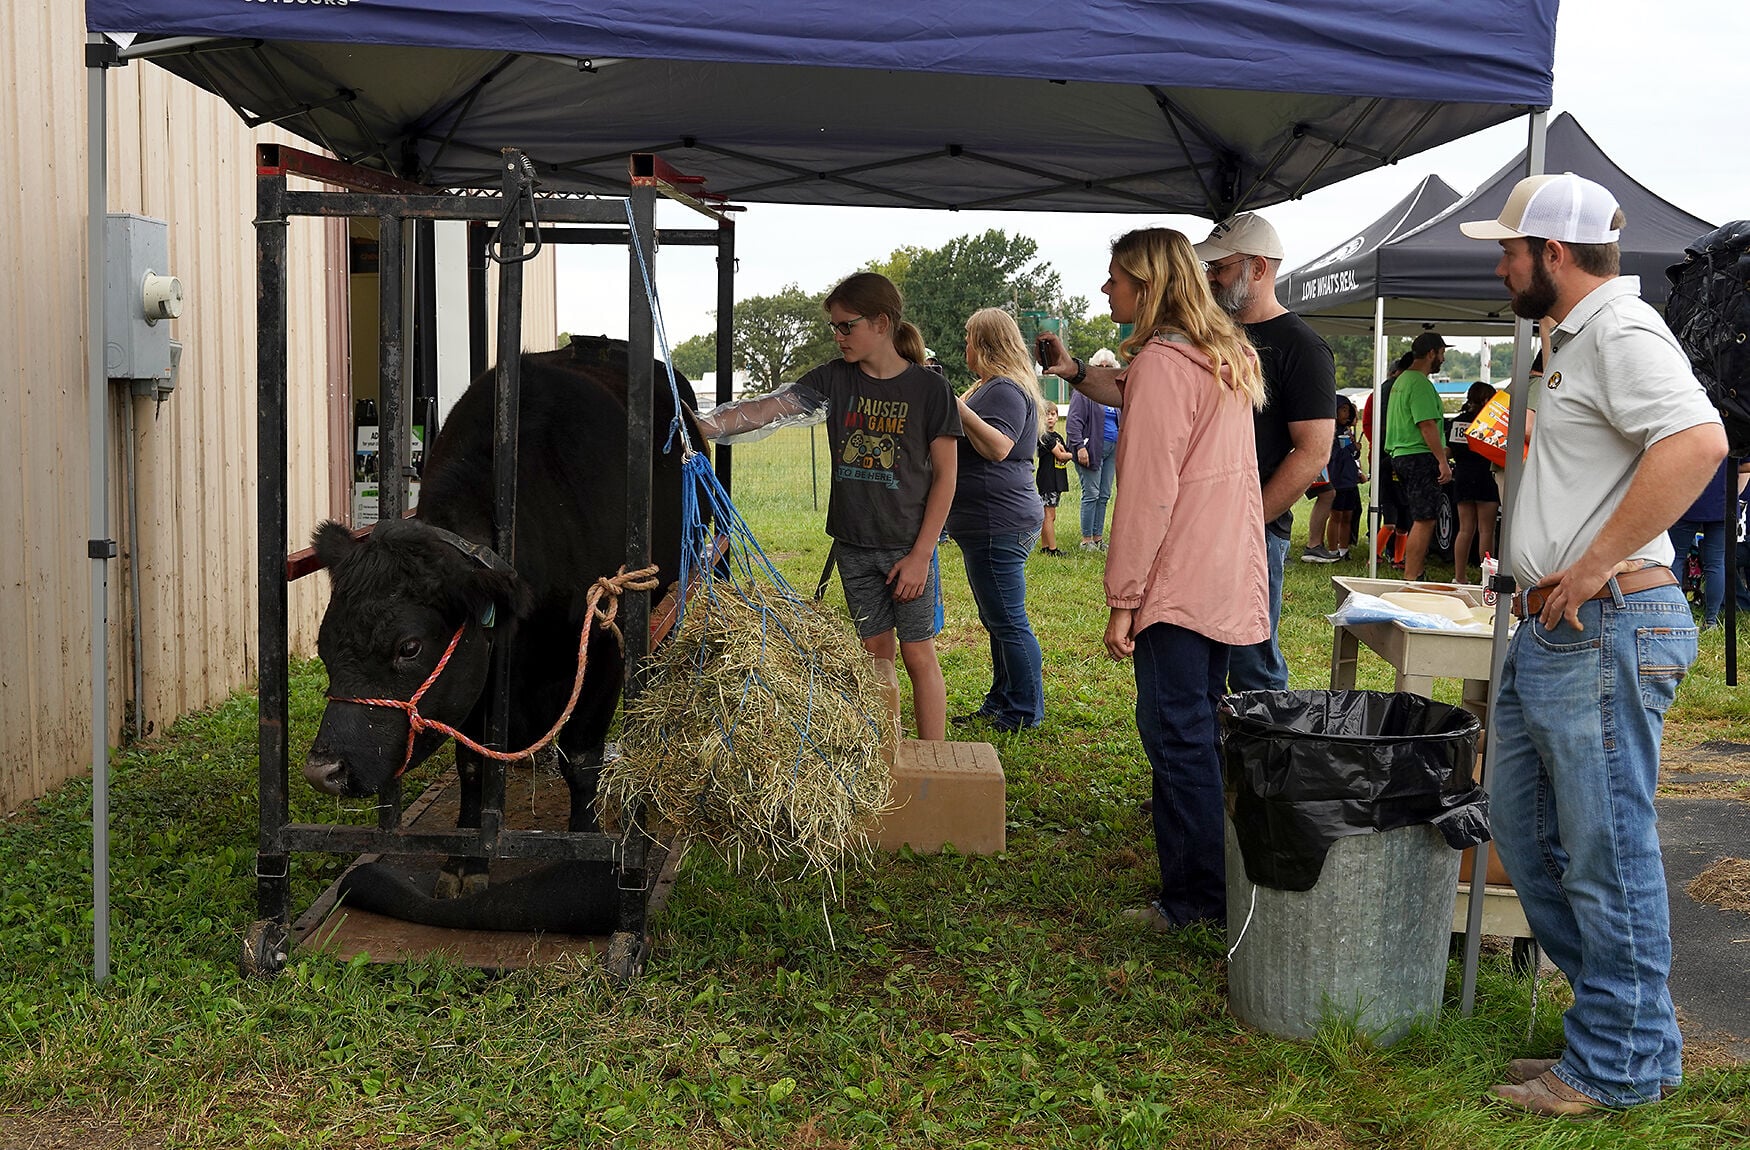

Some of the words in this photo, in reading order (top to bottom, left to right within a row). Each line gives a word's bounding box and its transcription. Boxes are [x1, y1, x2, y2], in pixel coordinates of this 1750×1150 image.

[1301, 279, 1316, 301] LOVE
[857, 396, 908, 418] PAUSED
[868, 416, 906, 434] GAME
[840, 469, 852, 477] TO
[855, 470, 867, 478] BE
[868, 471, 892, 481] HERE
